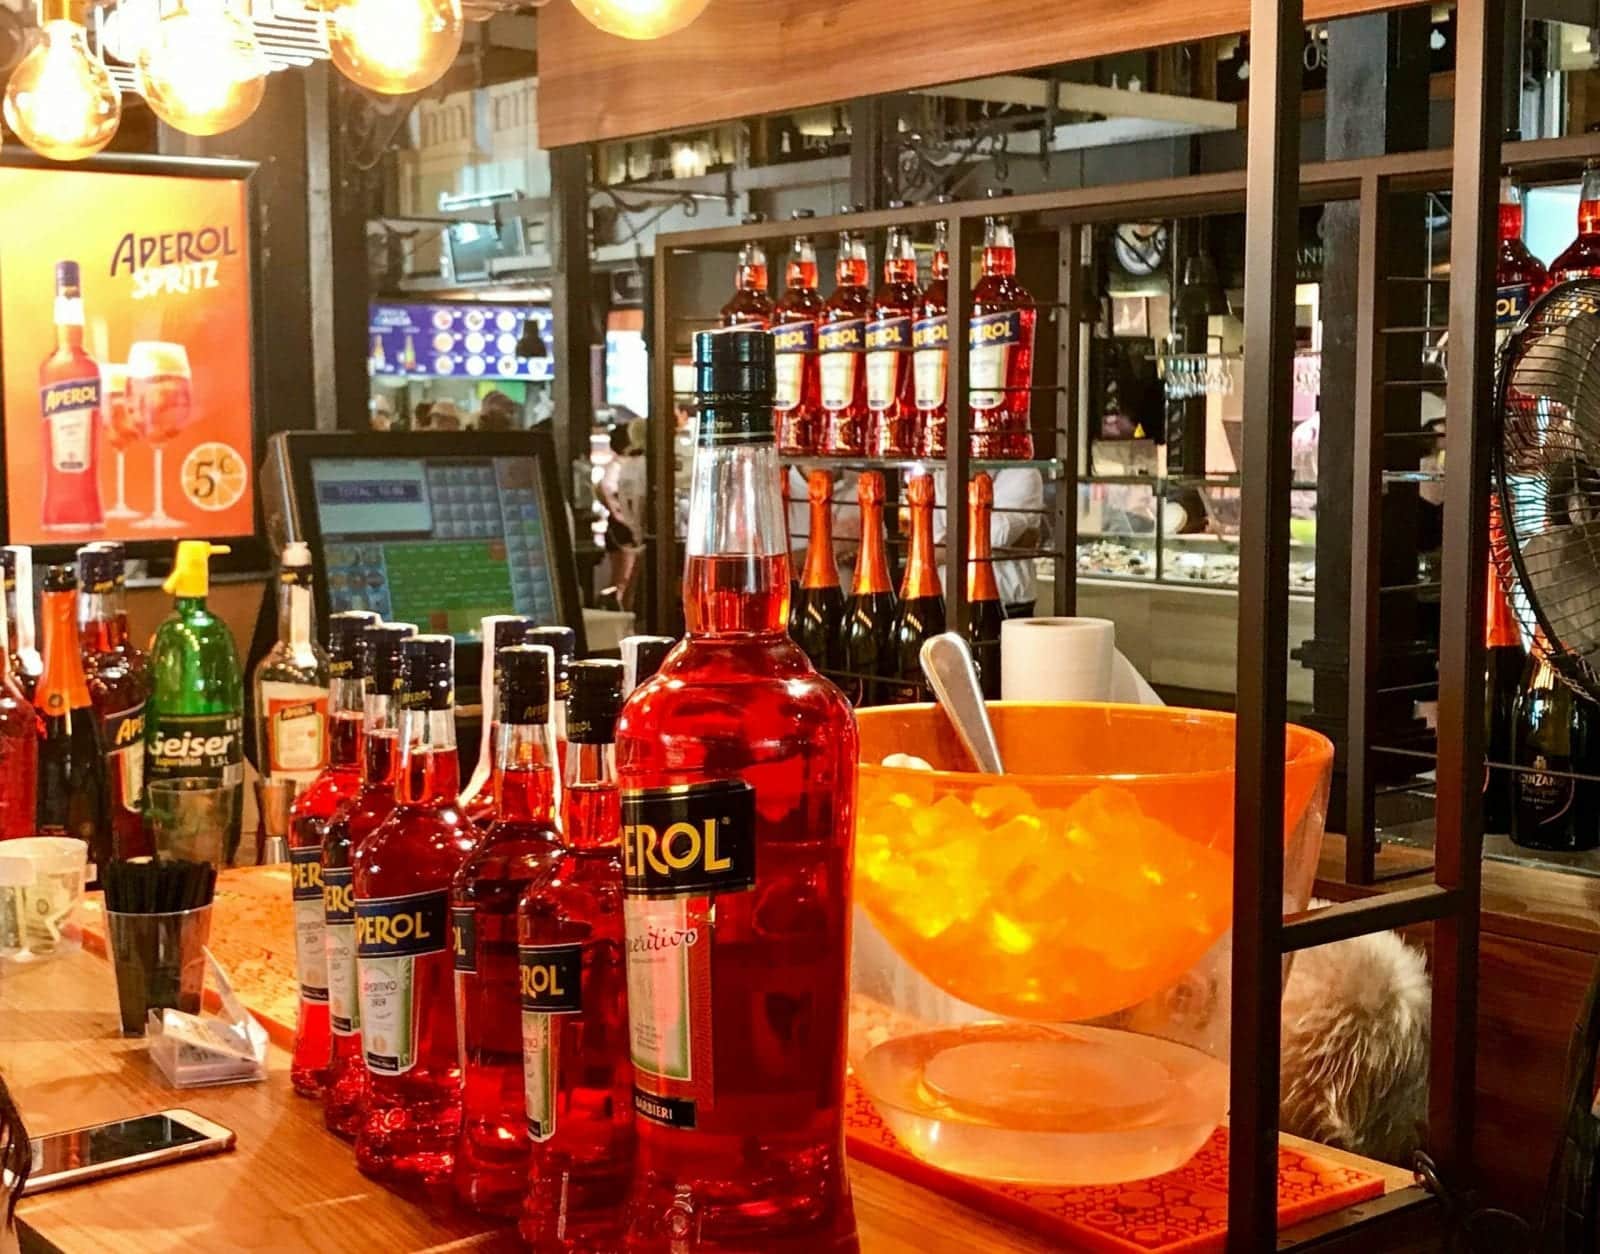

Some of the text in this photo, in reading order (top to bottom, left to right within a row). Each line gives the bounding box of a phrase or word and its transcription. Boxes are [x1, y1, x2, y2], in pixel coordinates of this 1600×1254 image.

[110, 226, 237, 277] APEROL
[131, 259, 219, 299] SPRITZ
[45, 385, 97, 412] APEROL
[624, 818, 731, 876] EROL
[354, 911, 431, 945] PEROL
